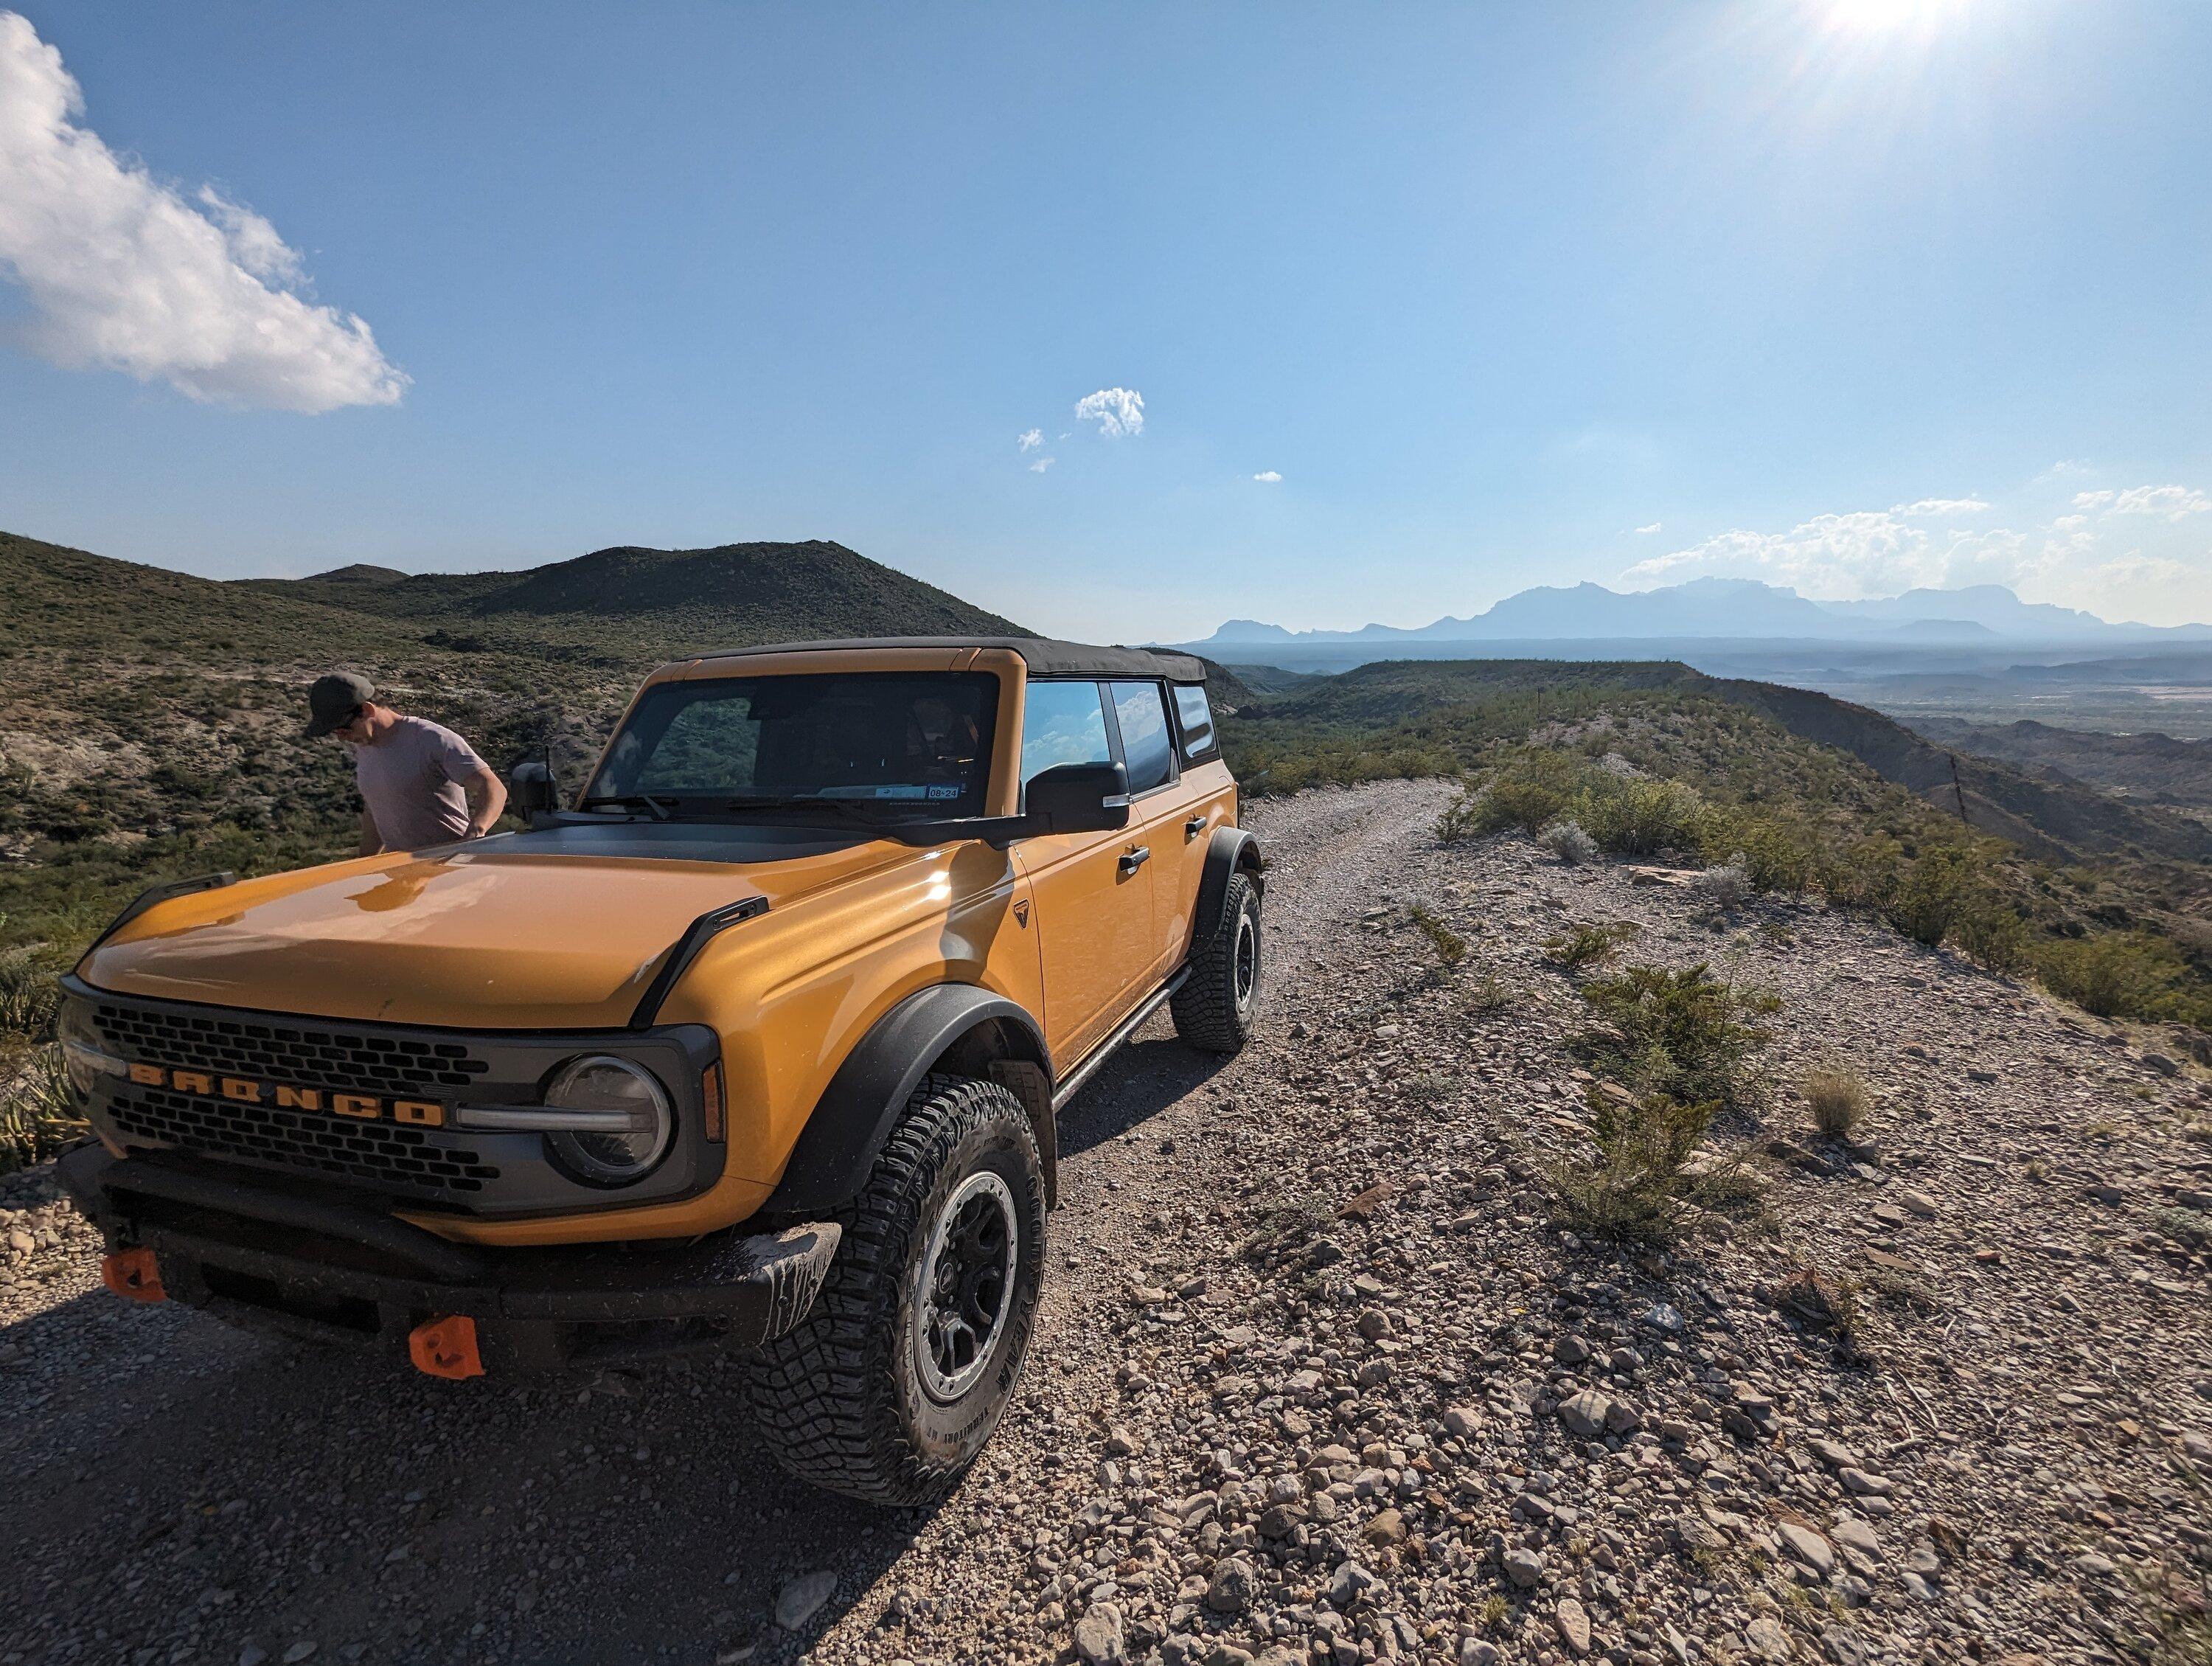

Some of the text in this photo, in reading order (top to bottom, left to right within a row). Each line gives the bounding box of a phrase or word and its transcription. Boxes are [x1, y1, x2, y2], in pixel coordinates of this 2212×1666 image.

[131, 1063, 443, 1127] BRONCO
[926, 1426, 939, 1442] MT
[943, 1406, 989, 1444] TERRITORY
